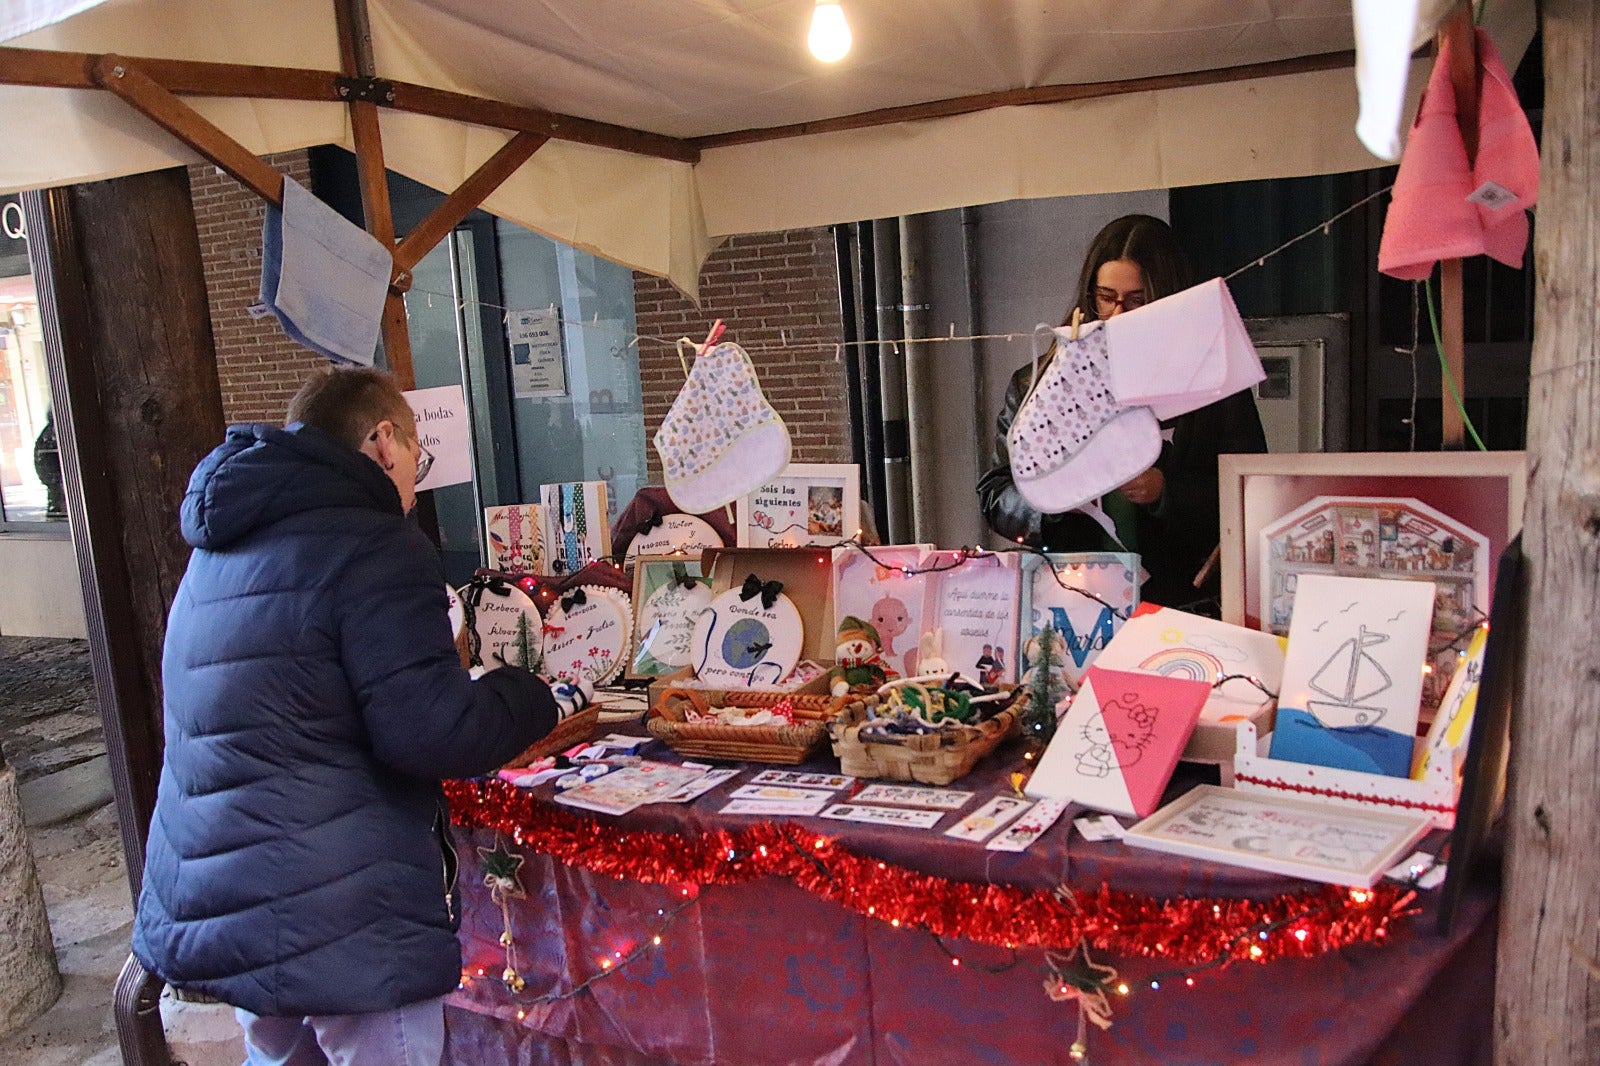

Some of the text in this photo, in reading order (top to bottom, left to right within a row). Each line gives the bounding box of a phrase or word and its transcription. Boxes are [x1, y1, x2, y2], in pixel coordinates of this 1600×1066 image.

[424, 407, 454, 421] bodas
[760, 485, 795, 494] Sois los
[755, 497, 801, 508] siguientes
[482, 602, 520, 612] Rebeca
[729, 605, 777, 619] Donde sea
[705, 667, 765, 682] pero contgo
